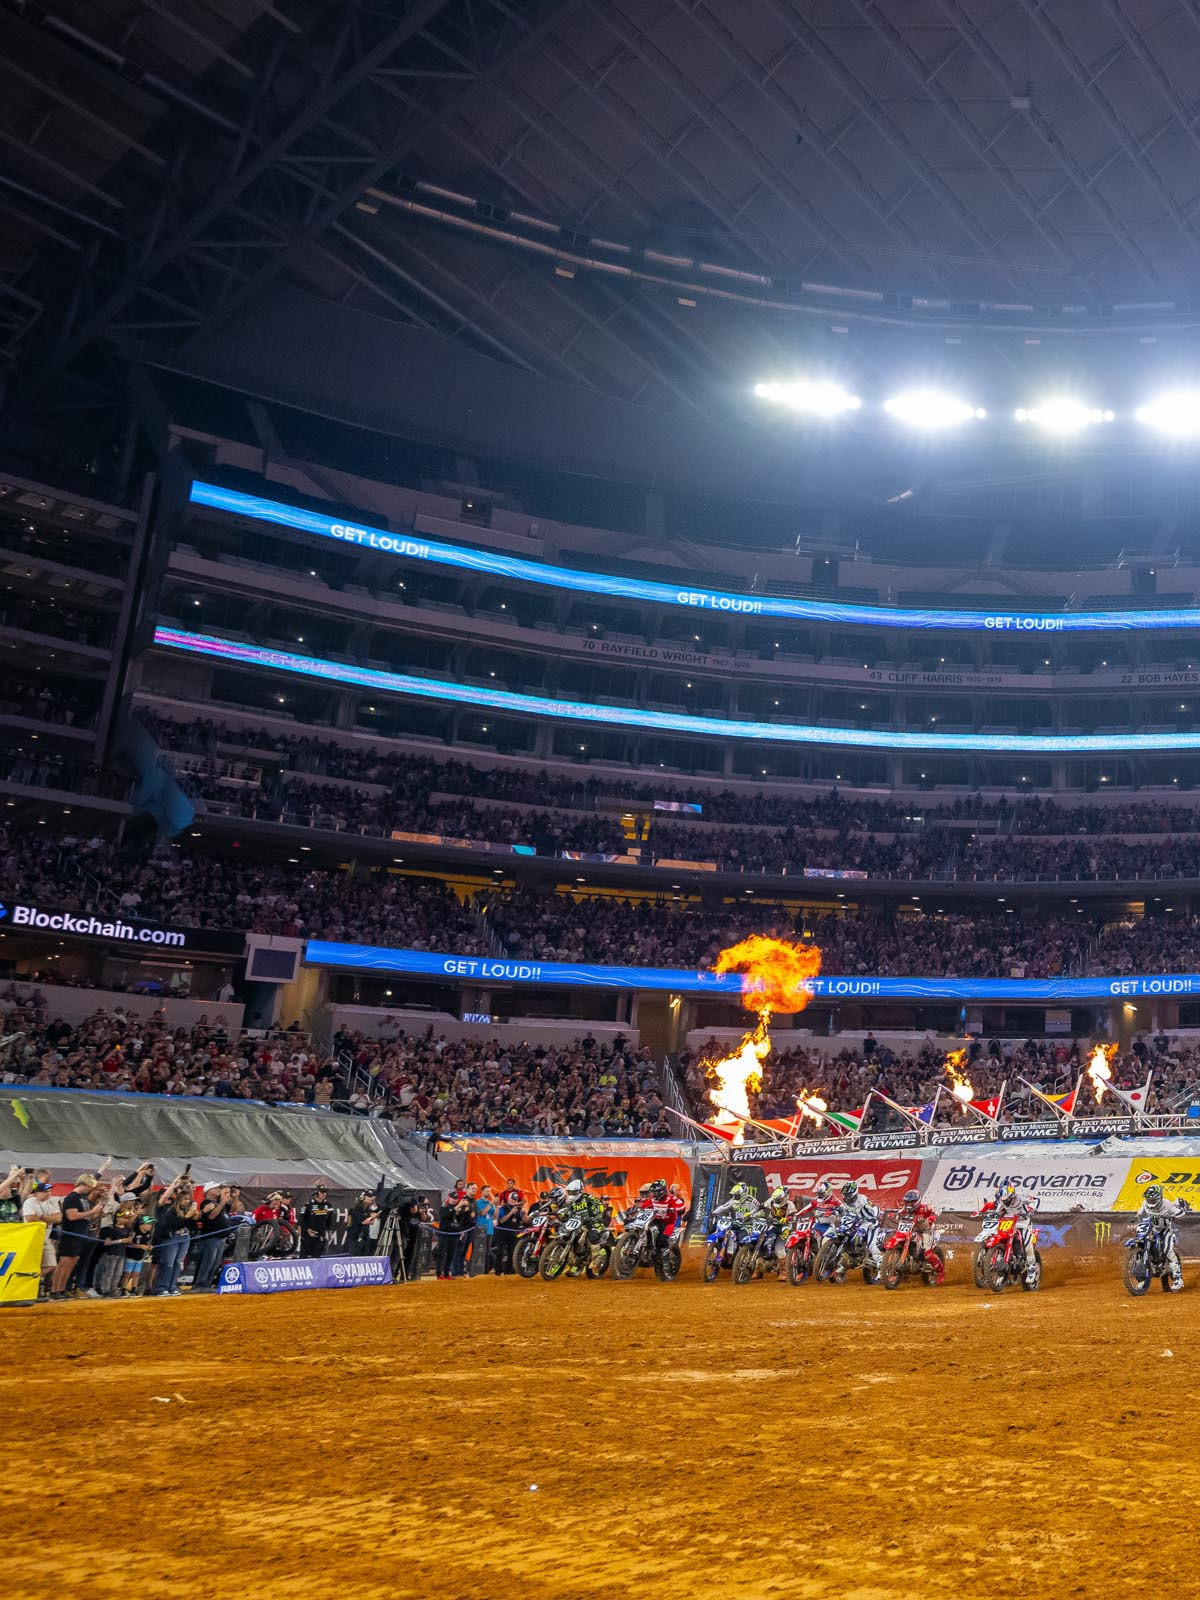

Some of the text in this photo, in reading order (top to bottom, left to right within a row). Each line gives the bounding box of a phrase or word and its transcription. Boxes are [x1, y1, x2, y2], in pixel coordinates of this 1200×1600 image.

[330, 524, 429, 558] GET LOUD!!
[677, 592, 762, 613] GET LOUD!!
[984, 617, 1063, 630] GET LOUD!!
[581, 639, 596, 650] 70
[601, 641, 659, 659] RAYFIELD
[662, 649, 707, 666] WRIGHT
[888, 673, 919, 683] CLIFF
[922, 674, 962, 684] HARRIS
[1138, 673, 1161, 683] BOB
[1164, 672, 1199, 682] HAYES
[12, 905, 187, 946] Blockchain.com
[443, 960, 541, 980] GET LOUD!!
[828, 981, 880, 995] LOUD!!
[1110, 979, 1191, 994] GET LOUD!!
[531, 1164, 629, 1188] KTM
[765, 1170, 912, 1191] ASGAS
[973, 1171, 1108, 1191] Husqvarna
[567, 1219, 579, 1229] 70
[983, 1221, 997, 1229] 27
[999, 1220, 1014, 1230] 18
[1138, 1223, 1150, 1233] 3
[267, 1266, 314, 1281] YAMAHA
[343, 1262, 385, 1276] YAMAHA
